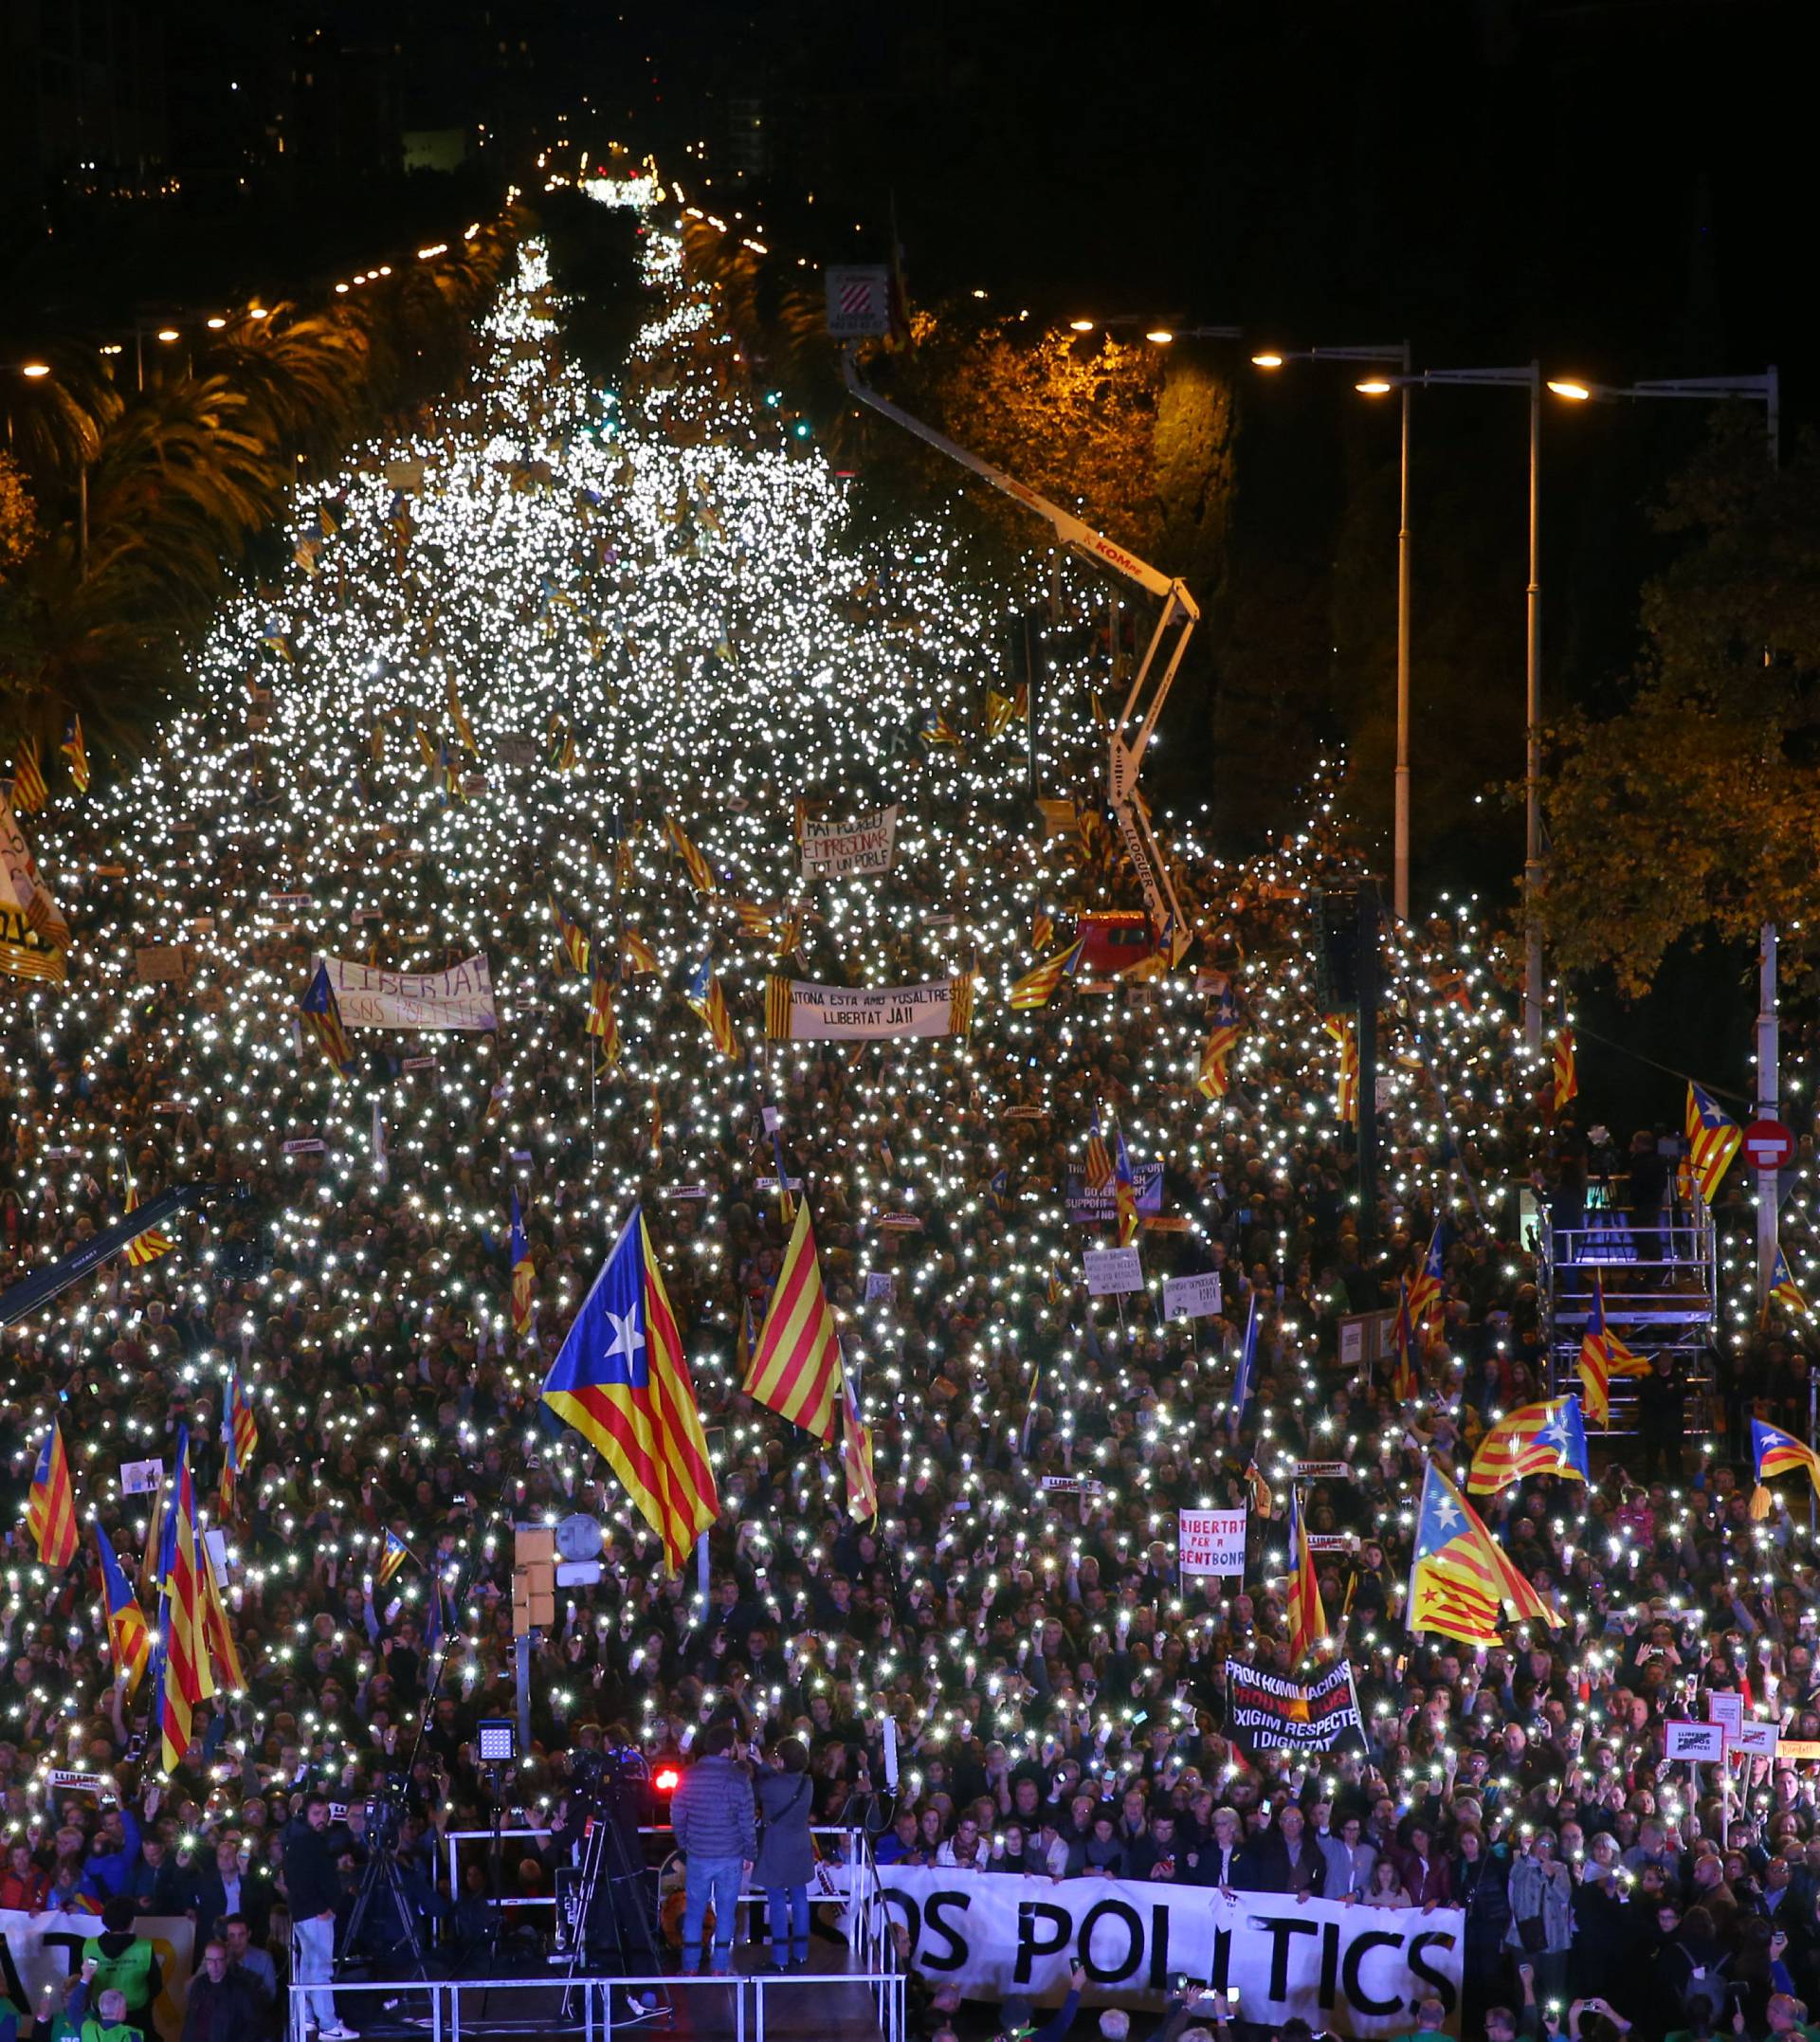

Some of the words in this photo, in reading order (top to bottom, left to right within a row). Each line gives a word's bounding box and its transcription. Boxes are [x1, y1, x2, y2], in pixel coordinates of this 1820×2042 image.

[837, 858, 852, 871] UN
[1124, 828, 1154, 888] LLOGUER
[824, 1011, 882, 1025] LLIBERTAT
[1192, 1537, 1210, 1547] PER
[1226, 1660, 1261, 1686] PROU
[1262, 1660, 1351, 1700] HUMILIACIONS
[1284, 1707, 1360, 1737] RESPECTE
[1261, 1731, 1332, 1753] DIGNITAT
[1013, 1899, 1457, 2017] POLITICS
